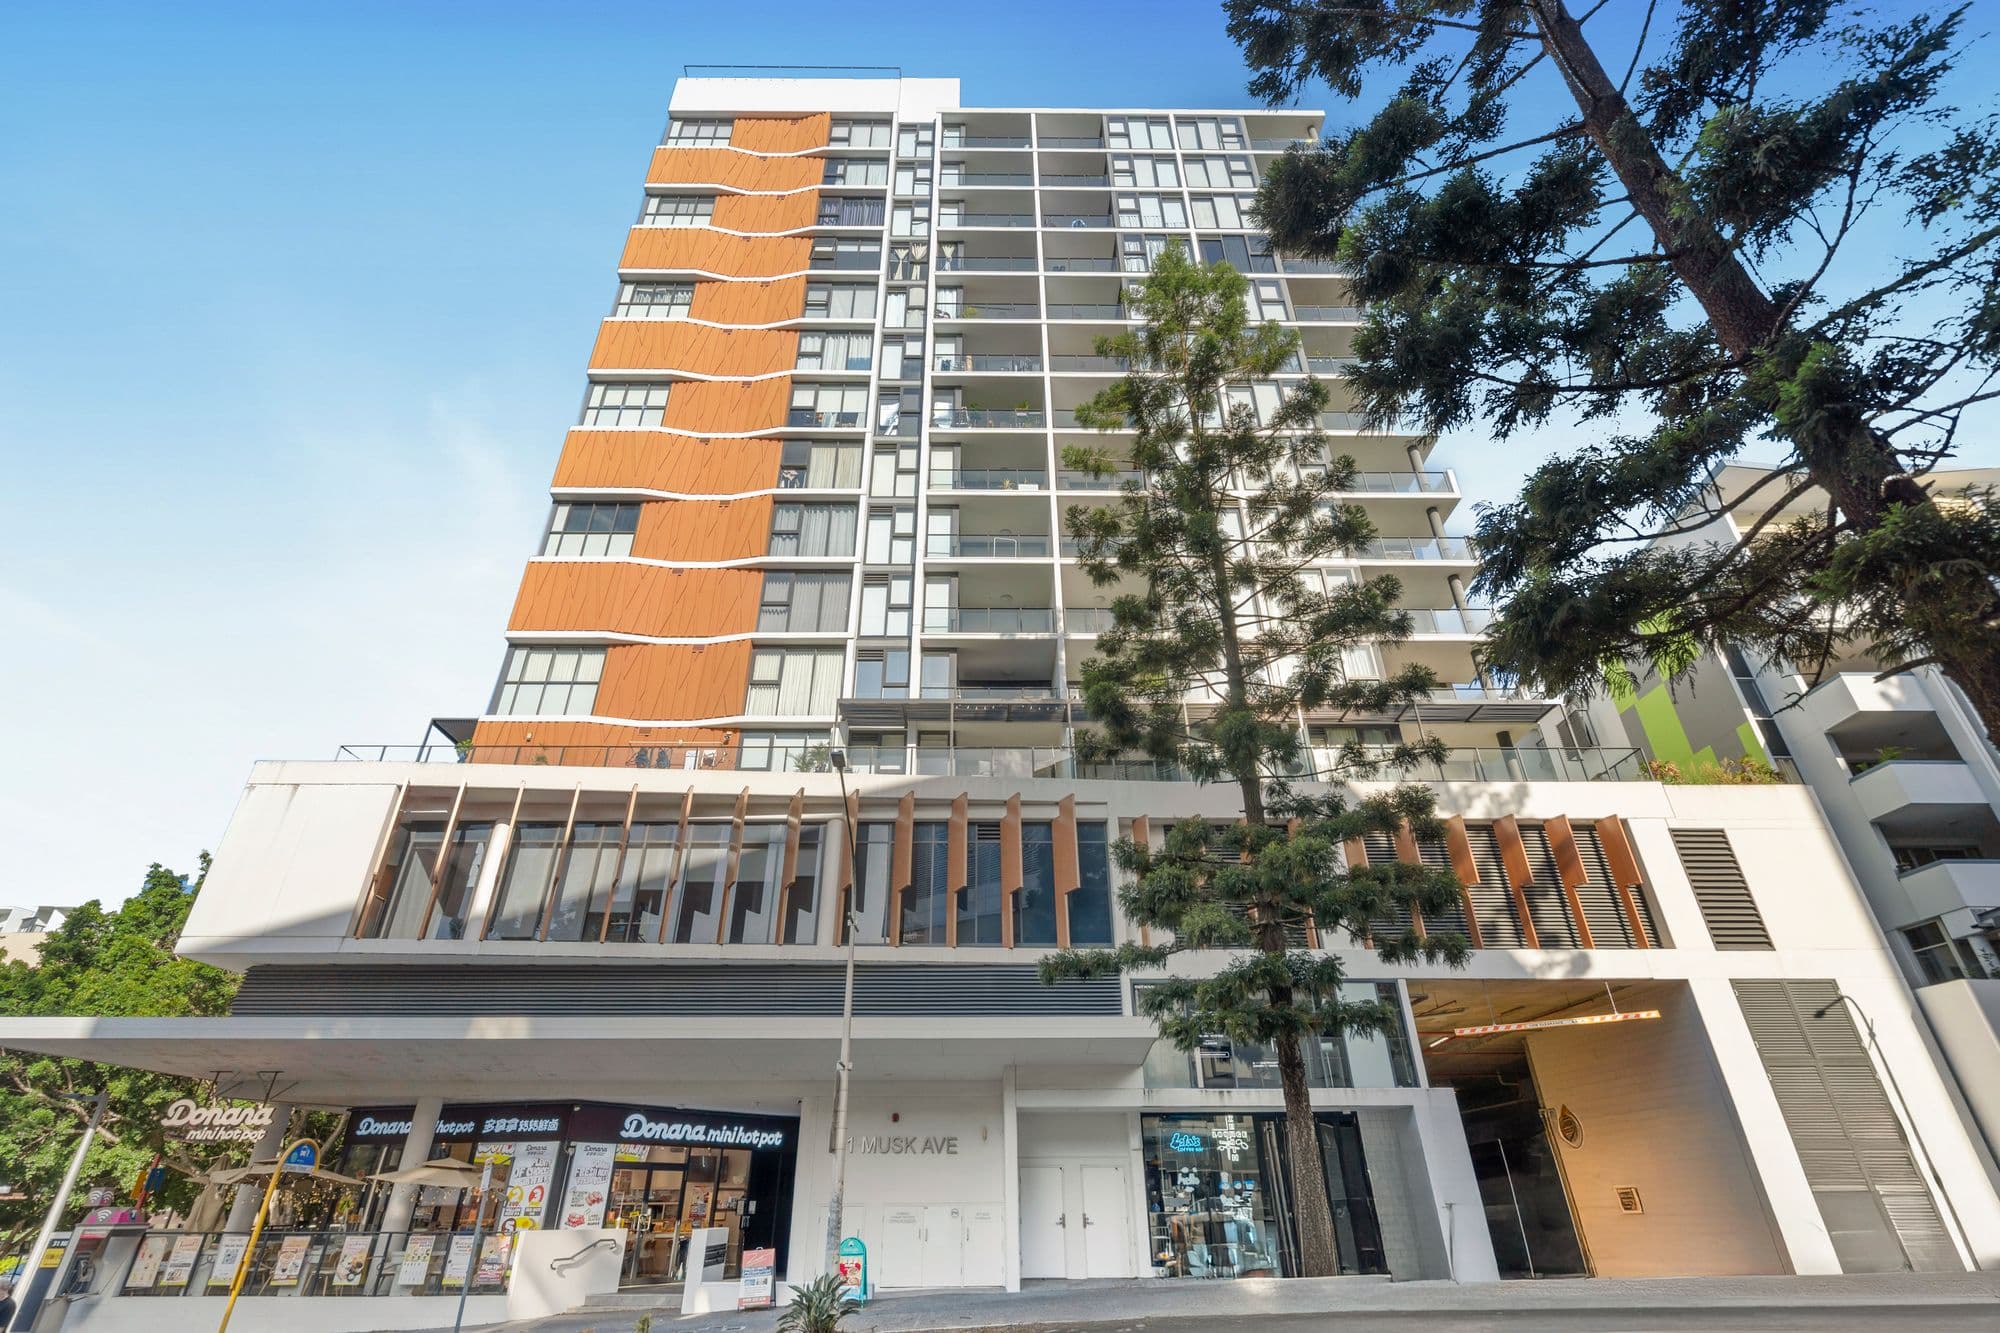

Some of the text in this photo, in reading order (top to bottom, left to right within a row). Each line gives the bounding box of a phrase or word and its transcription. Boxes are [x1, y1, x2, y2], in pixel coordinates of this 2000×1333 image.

[161, 1099, 276, 1126] Donana
[620, 1113, 707, 1142] Donana
[861, 1136, 917, 1154] MUSK
[921, 1136, 958, 1155] AVE
